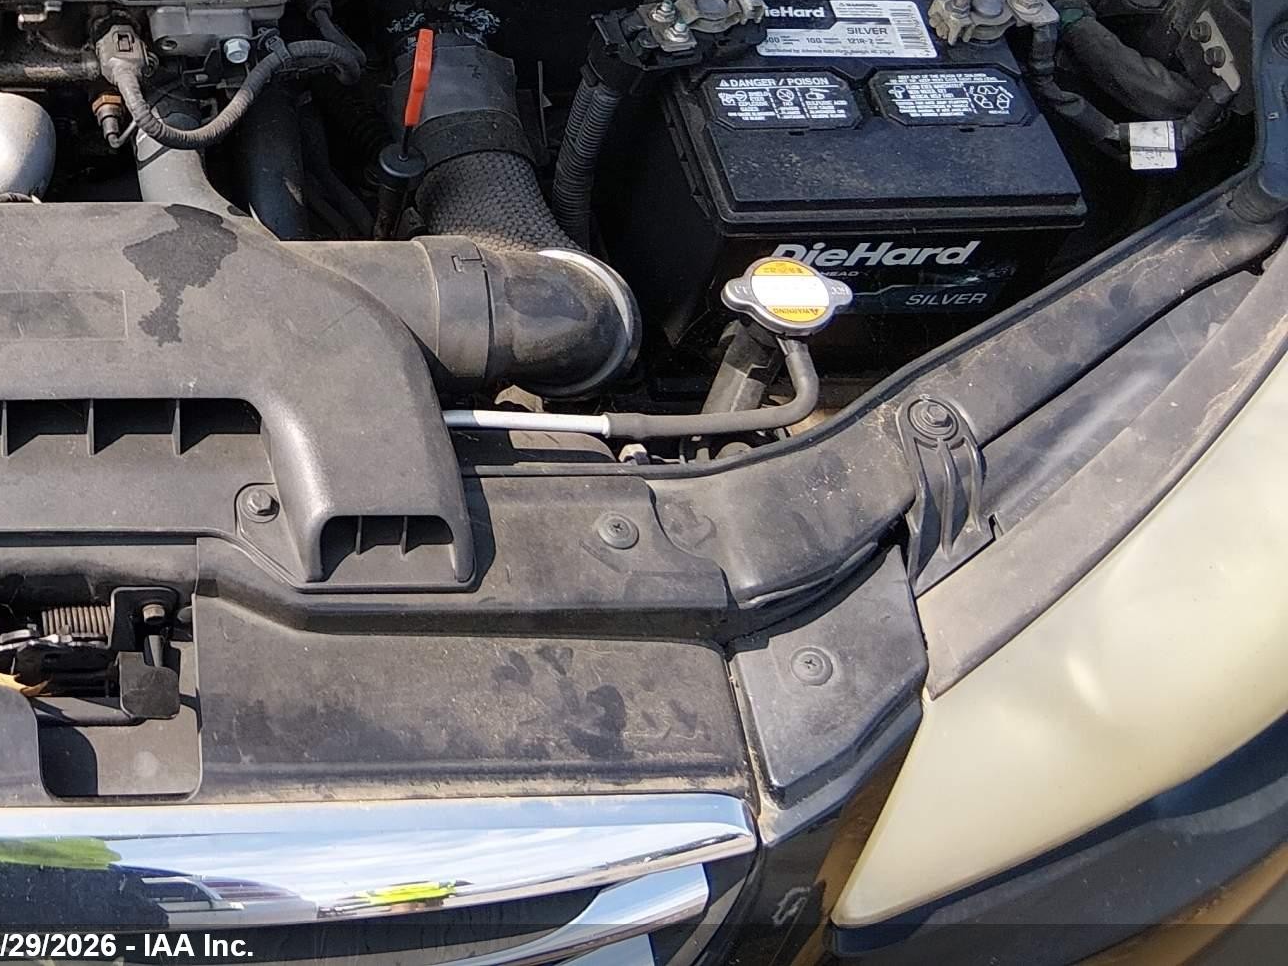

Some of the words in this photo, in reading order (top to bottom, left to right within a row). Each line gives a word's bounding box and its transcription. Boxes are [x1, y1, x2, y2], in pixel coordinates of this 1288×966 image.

[764, 6, 825, 18] ieHard
[846, 27, 889, 36] SILVER
[729, 79, 776, 87] DANGER
[787, 77, 829, 85] POISON
[770, 240, 981, 267] DieHard
[905, 293, 988, 306] SILVER
